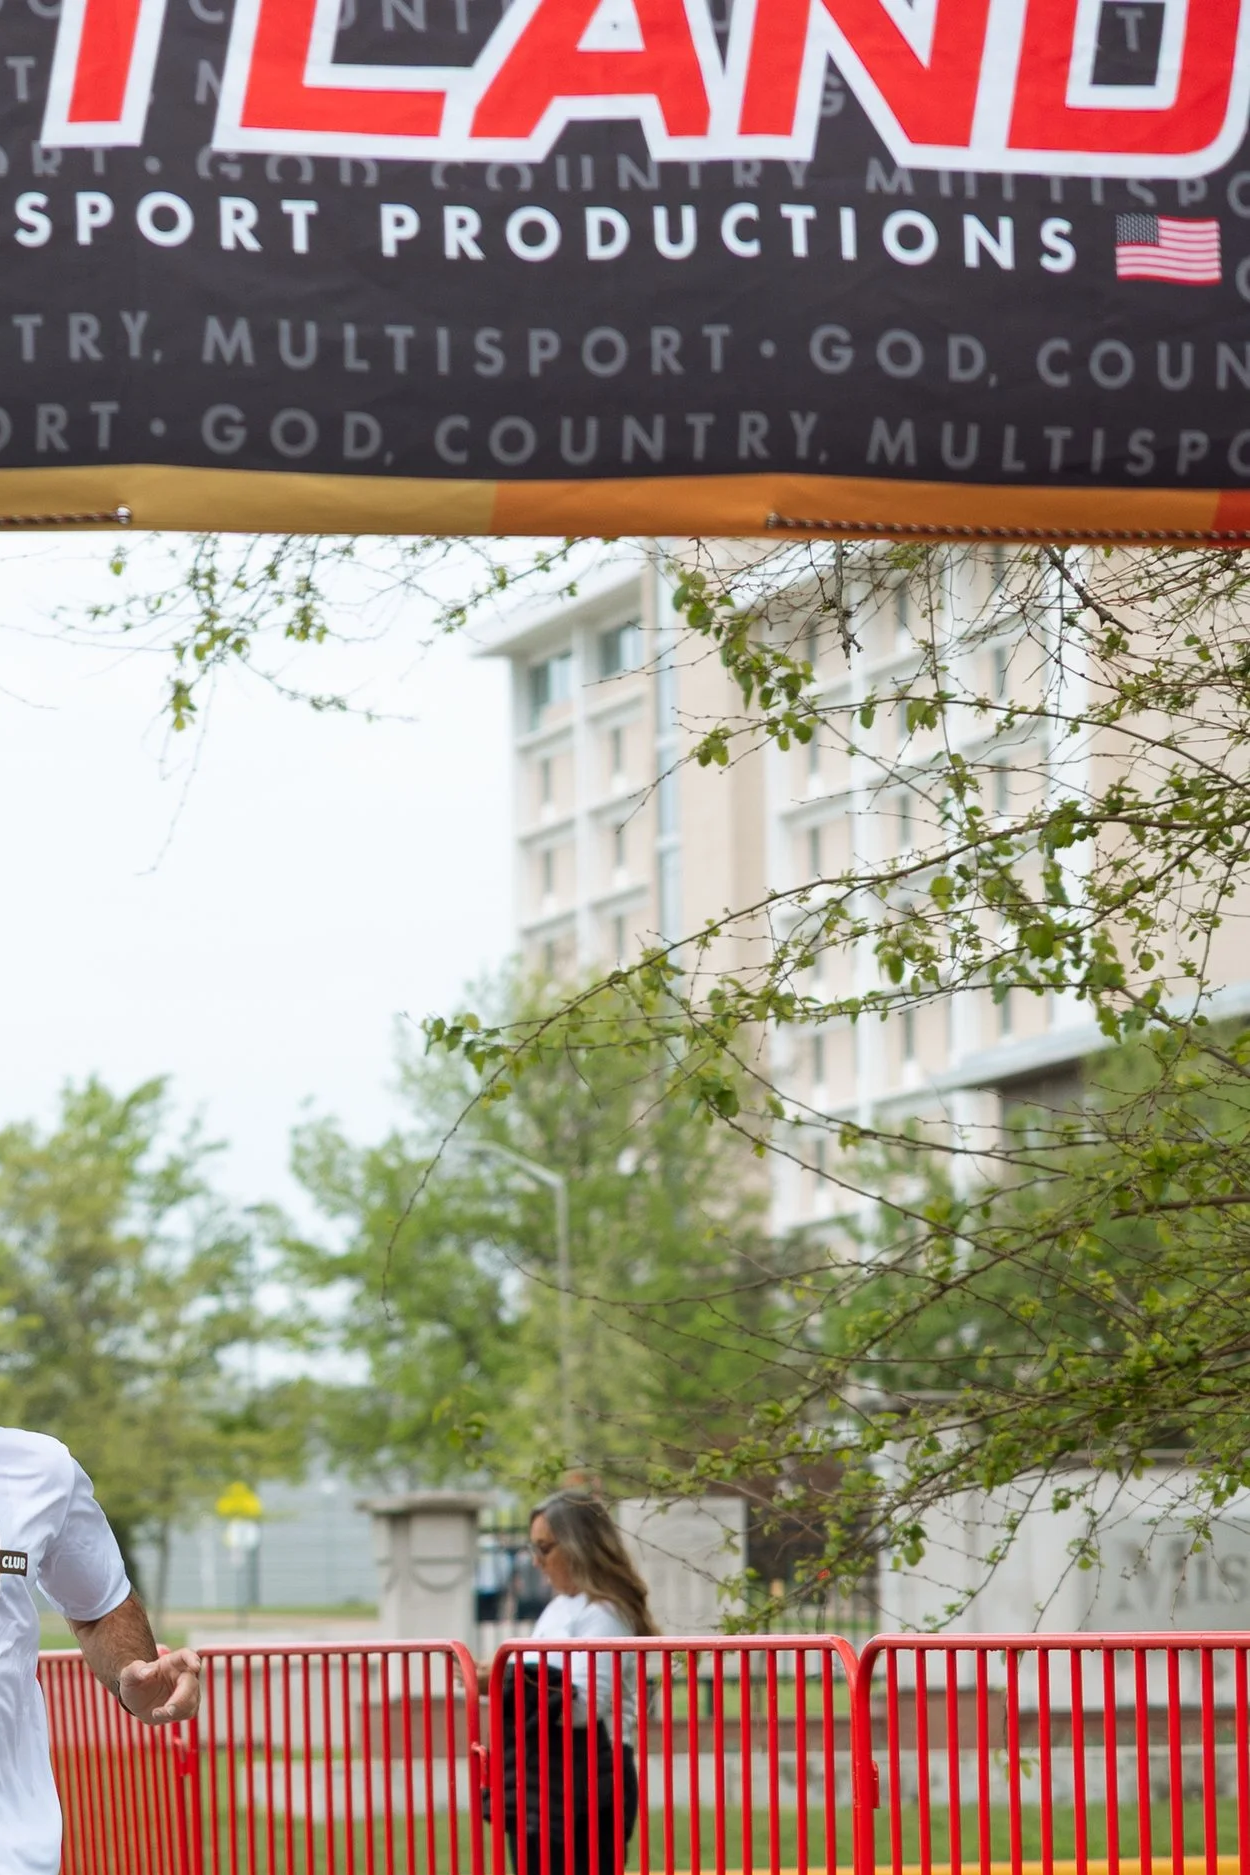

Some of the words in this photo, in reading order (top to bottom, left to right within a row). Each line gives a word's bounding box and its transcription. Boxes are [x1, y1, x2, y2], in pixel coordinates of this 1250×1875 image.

[380, 201, 1078, 274] PRODUCTIONS
[202, 316, 732, 378] MULTISPORT
[808, 323, 999, 389] GOD,
[201, 404, 394, 466] GOD,
[434, 410, 828, 464] COUNTRY,
[1, 1555, 26, 1570] CLUB
